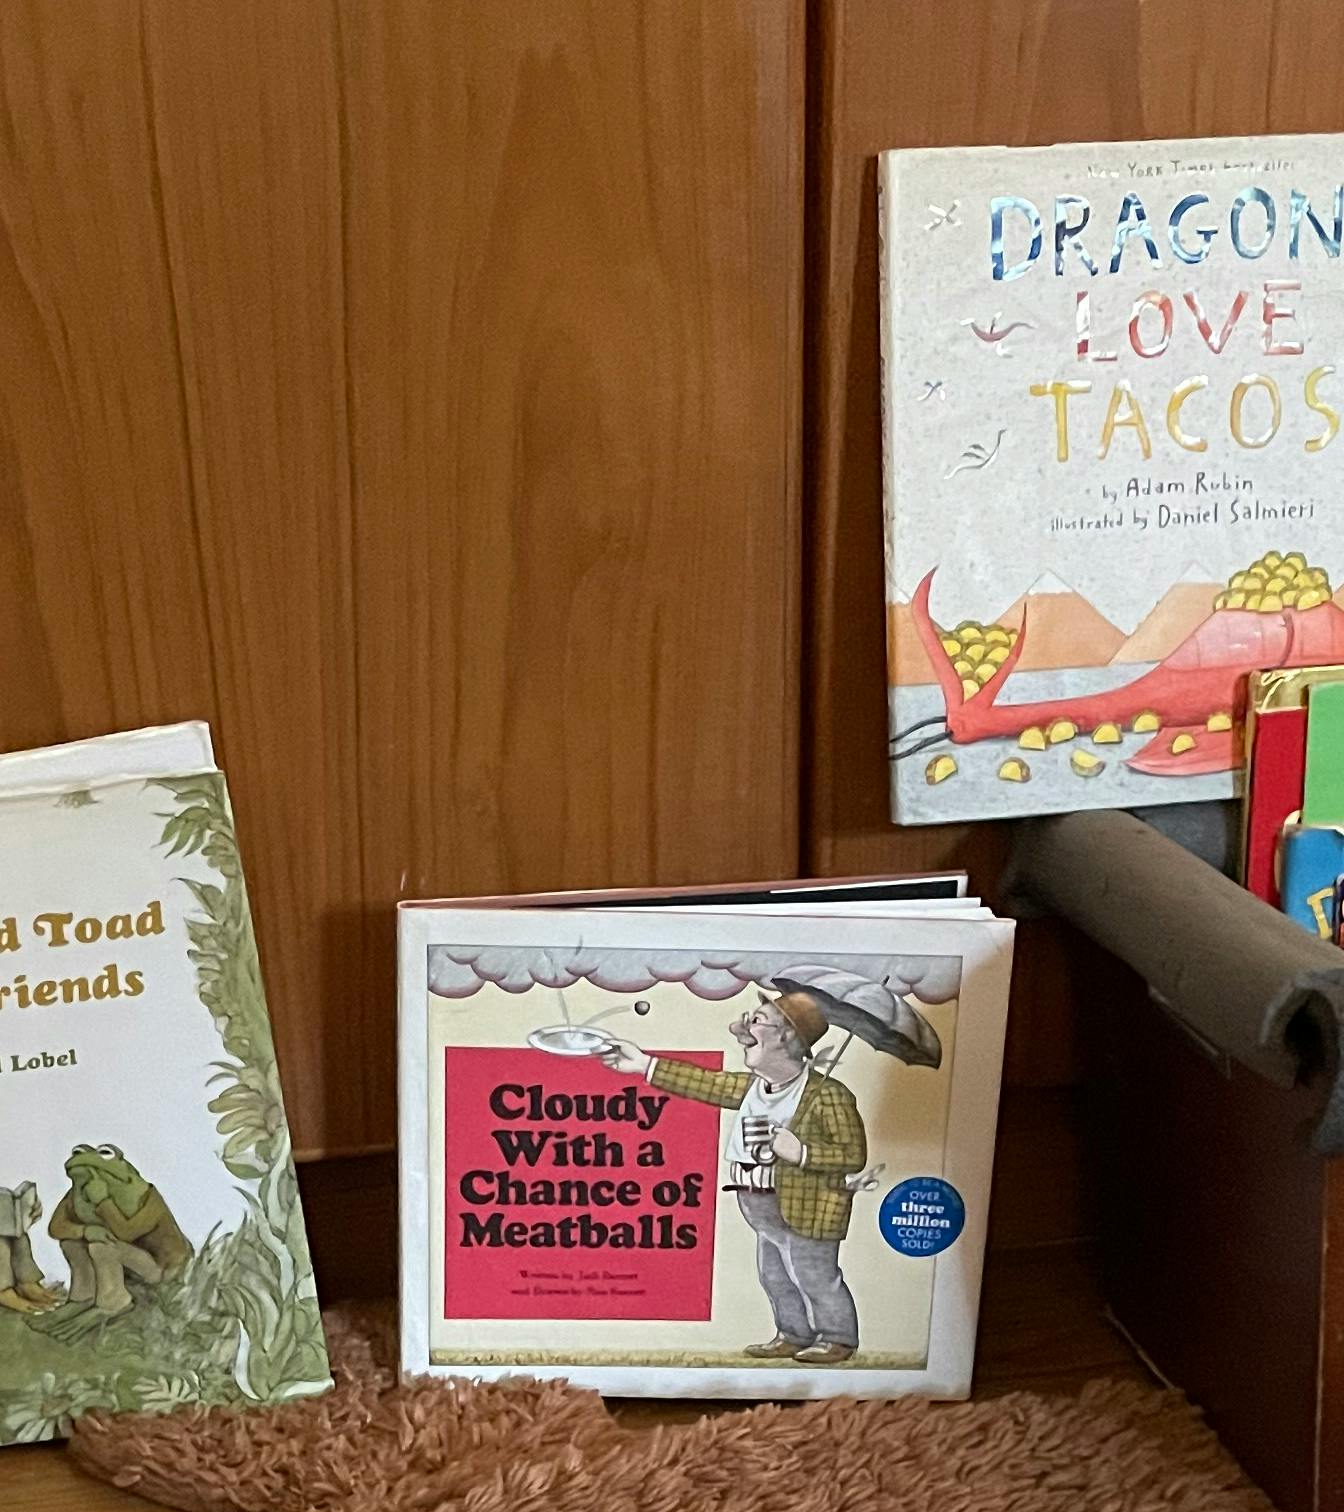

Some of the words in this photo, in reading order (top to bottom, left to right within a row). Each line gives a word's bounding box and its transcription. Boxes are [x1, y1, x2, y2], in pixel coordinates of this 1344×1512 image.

[1075, 279, 1305, 363] LOVE
[1029, 365, 1341, 462] TACOS
[1102, 484, 1118, 503] by
[1126, 477, 1185, 498] Adam
[1195, 471, 1253, 495] Rubin
[1050, 513, 1123, 531] illustrated
[1133, 509, 1148, 530] by
[1158, 503, 1218, 529] Daniel
[1230, 499, 1314, 524] Salmieri
[33, 901, 166, 949] Toad
[10, 1048, 78, 1074] Lobel
[489, 1084, 670, 1131] Cloudy
[493, 1130, 625, 1168] With
[634, 1139, 665, 1168] a
[459, 1169, 643, 1207] Chance
[652, 1172, 704, 1208] of
[909, 1190, 940, 1201] OVER
[891, 1214, 950, 1228] million
[901, 1201, 945, 1214] three
[459, 1212, 698, 1251] Meatballs
[897, 1227, 942, 1240] COPIES
